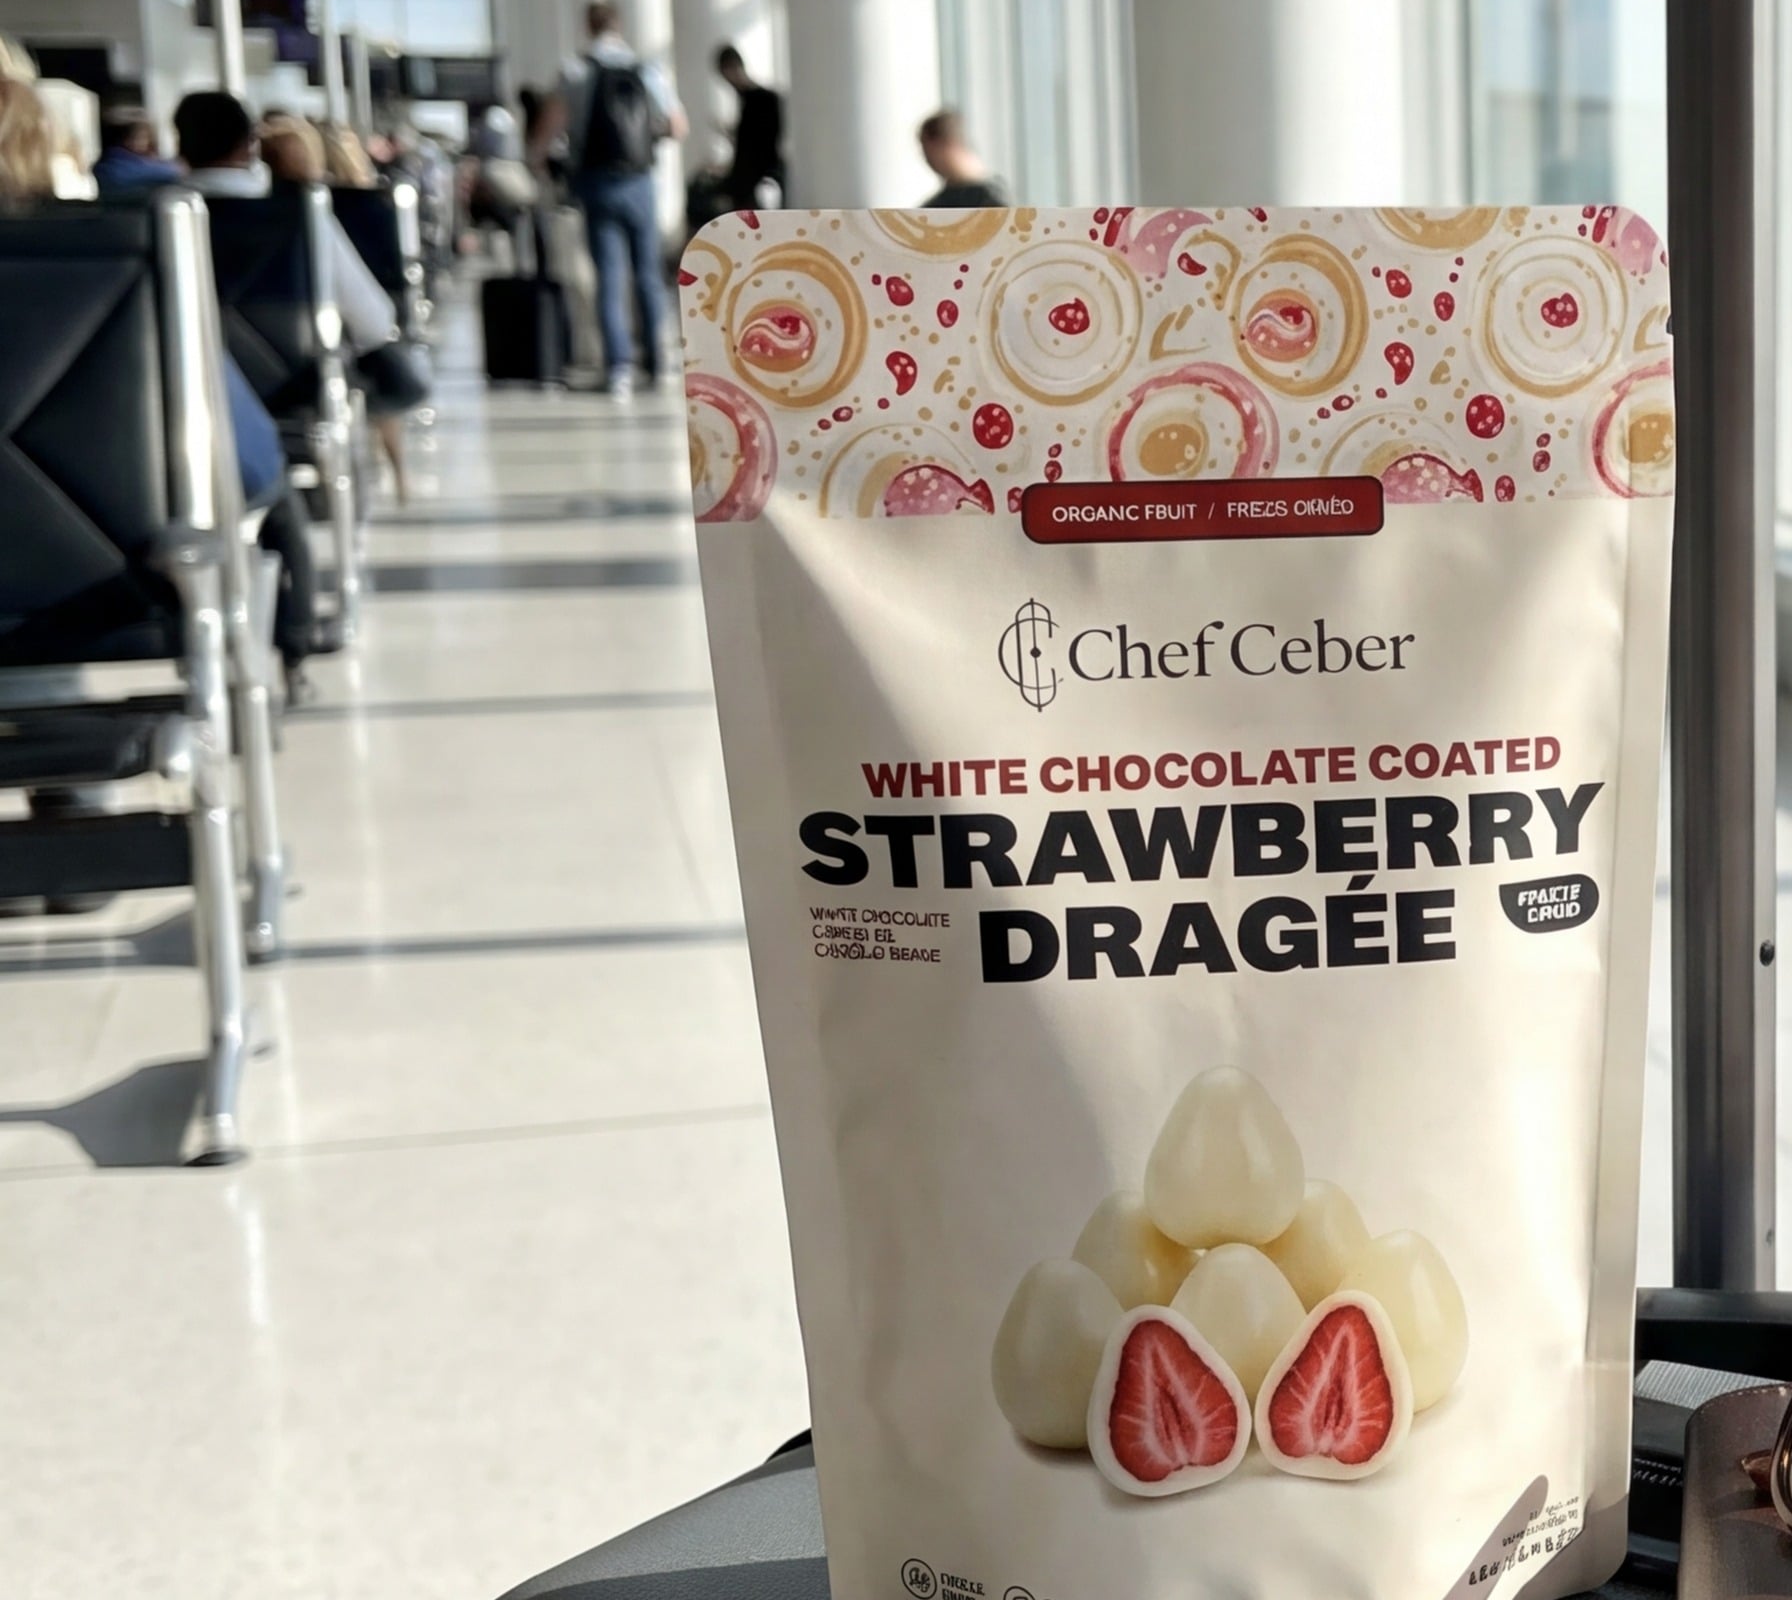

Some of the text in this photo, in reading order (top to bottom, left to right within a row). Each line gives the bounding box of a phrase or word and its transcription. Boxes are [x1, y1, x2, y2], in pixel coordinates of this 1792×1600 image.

[1068, 618, 1416, 681] Chef Ceber
[861, 736, 1562, 798] WHITE CHOCOLATE COATED
[798, 782, 1604, 889] STRAWBERRY
[978, 875, 1457, 984] DRAGÉE
